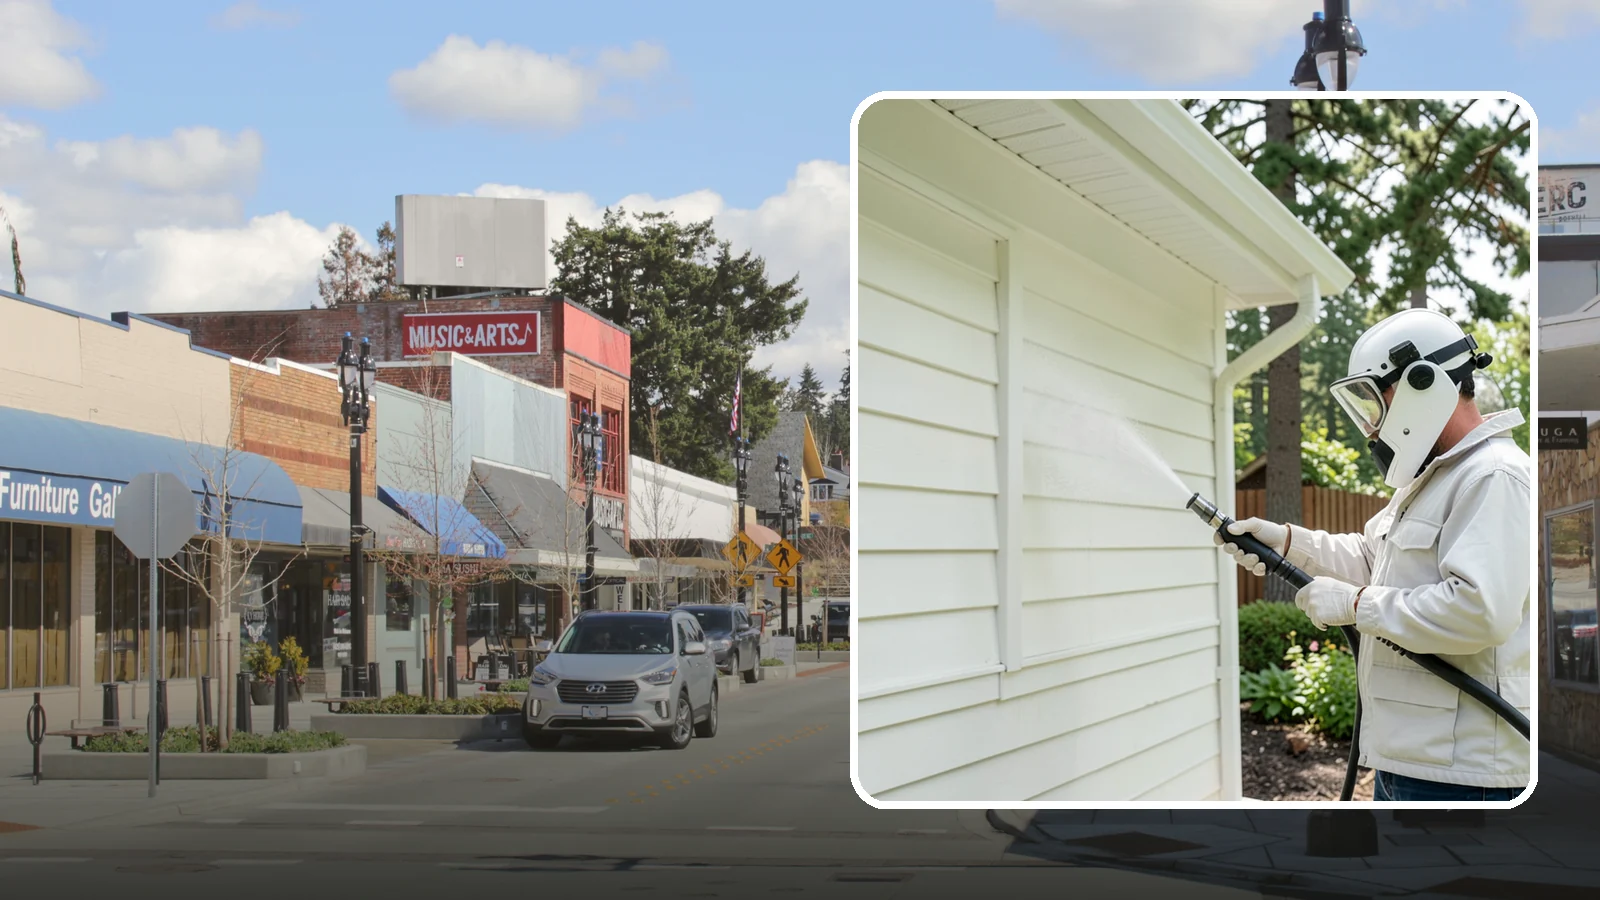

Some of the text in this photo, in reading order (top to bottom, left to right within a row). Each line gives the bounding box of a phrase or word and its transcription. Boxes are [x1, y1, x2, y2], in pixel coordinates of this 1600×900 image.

[409, 323, 519, 349] MUSIC&ARTS
[0, 471, 79, 515] Furniture
[453, 563, 480, 574] SUSHI
